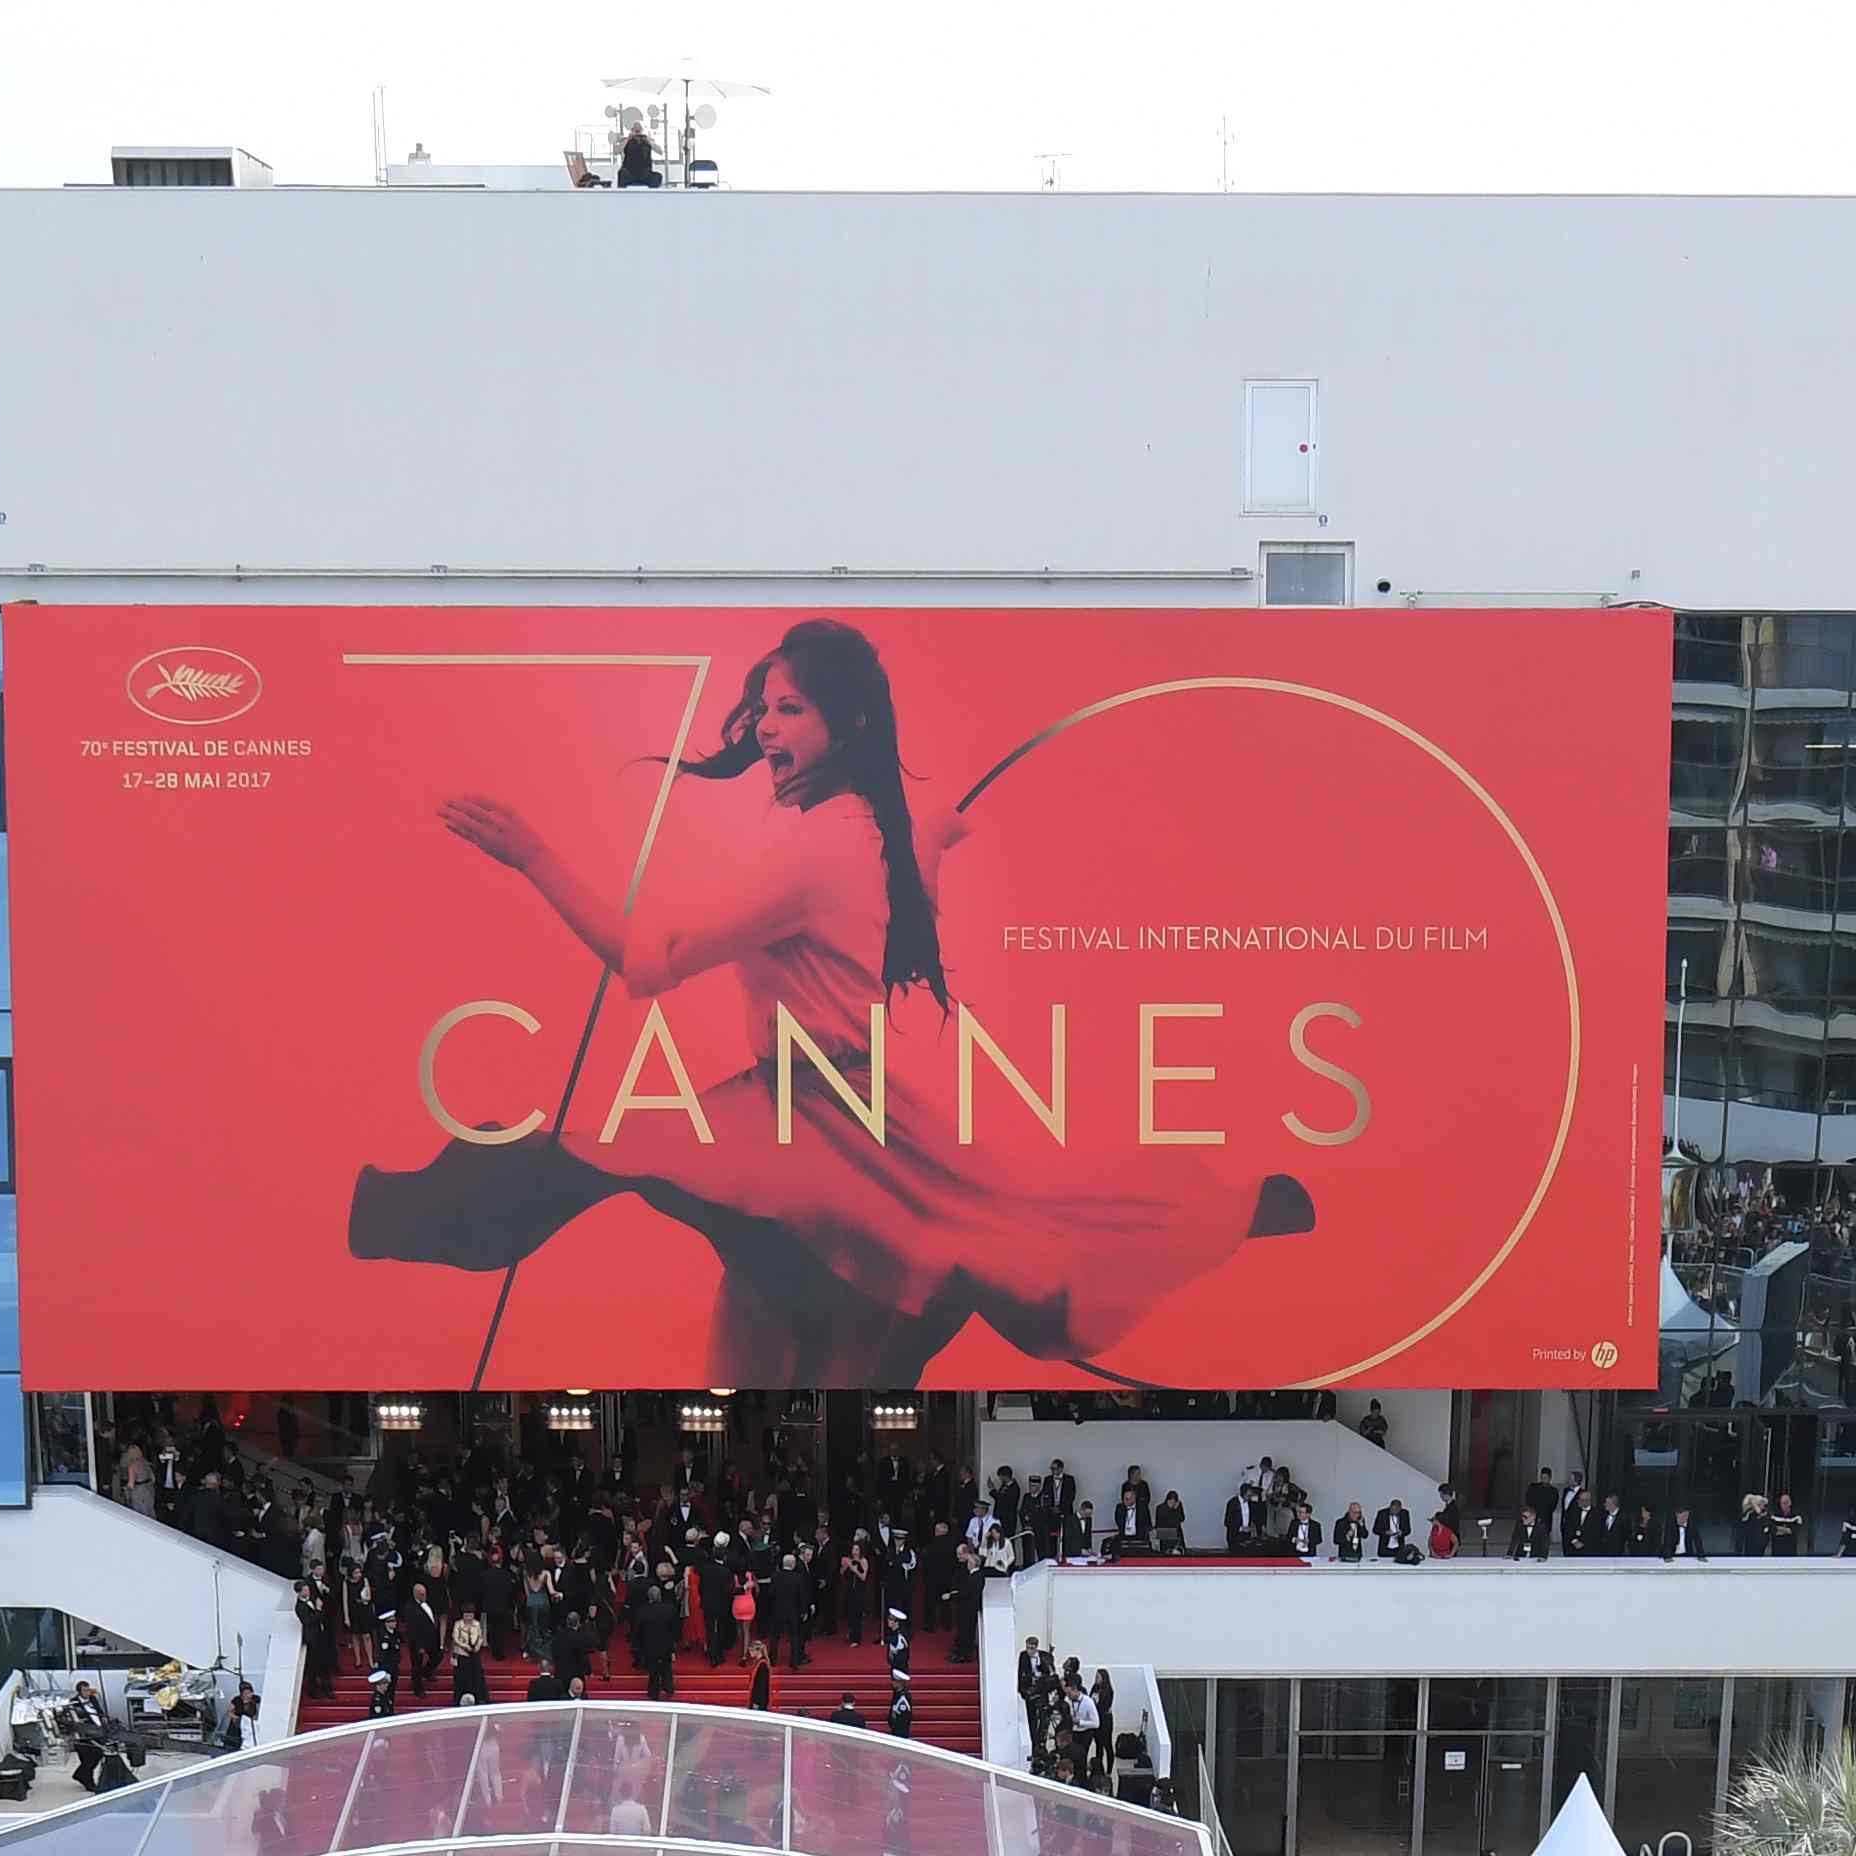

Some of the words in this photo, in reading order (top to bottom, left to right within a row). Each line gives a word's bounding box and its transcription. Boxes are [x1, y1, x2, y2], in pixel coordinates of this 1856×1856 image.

[112, 741, 200, 757] FESTIVAL
[204, 741, 229, 757] DE
[234, 740, 312, 757] CANNES
[185, 773, 220, 788] MAI
[226, 772, 271, 788] 2017
[1003, 926, 1125, 951] FESTIVAL
[1139, 926, 1366, 951] INTERNATIONAL
[1376, 926, 1414, 951] DU
[1424, 926, 1489, 951] FILM
[418, 999, 1372, 1148] CANNES
[1532, 1347, 1571, 1361] Printed
[1573, 1347, 1587, 1362] by
